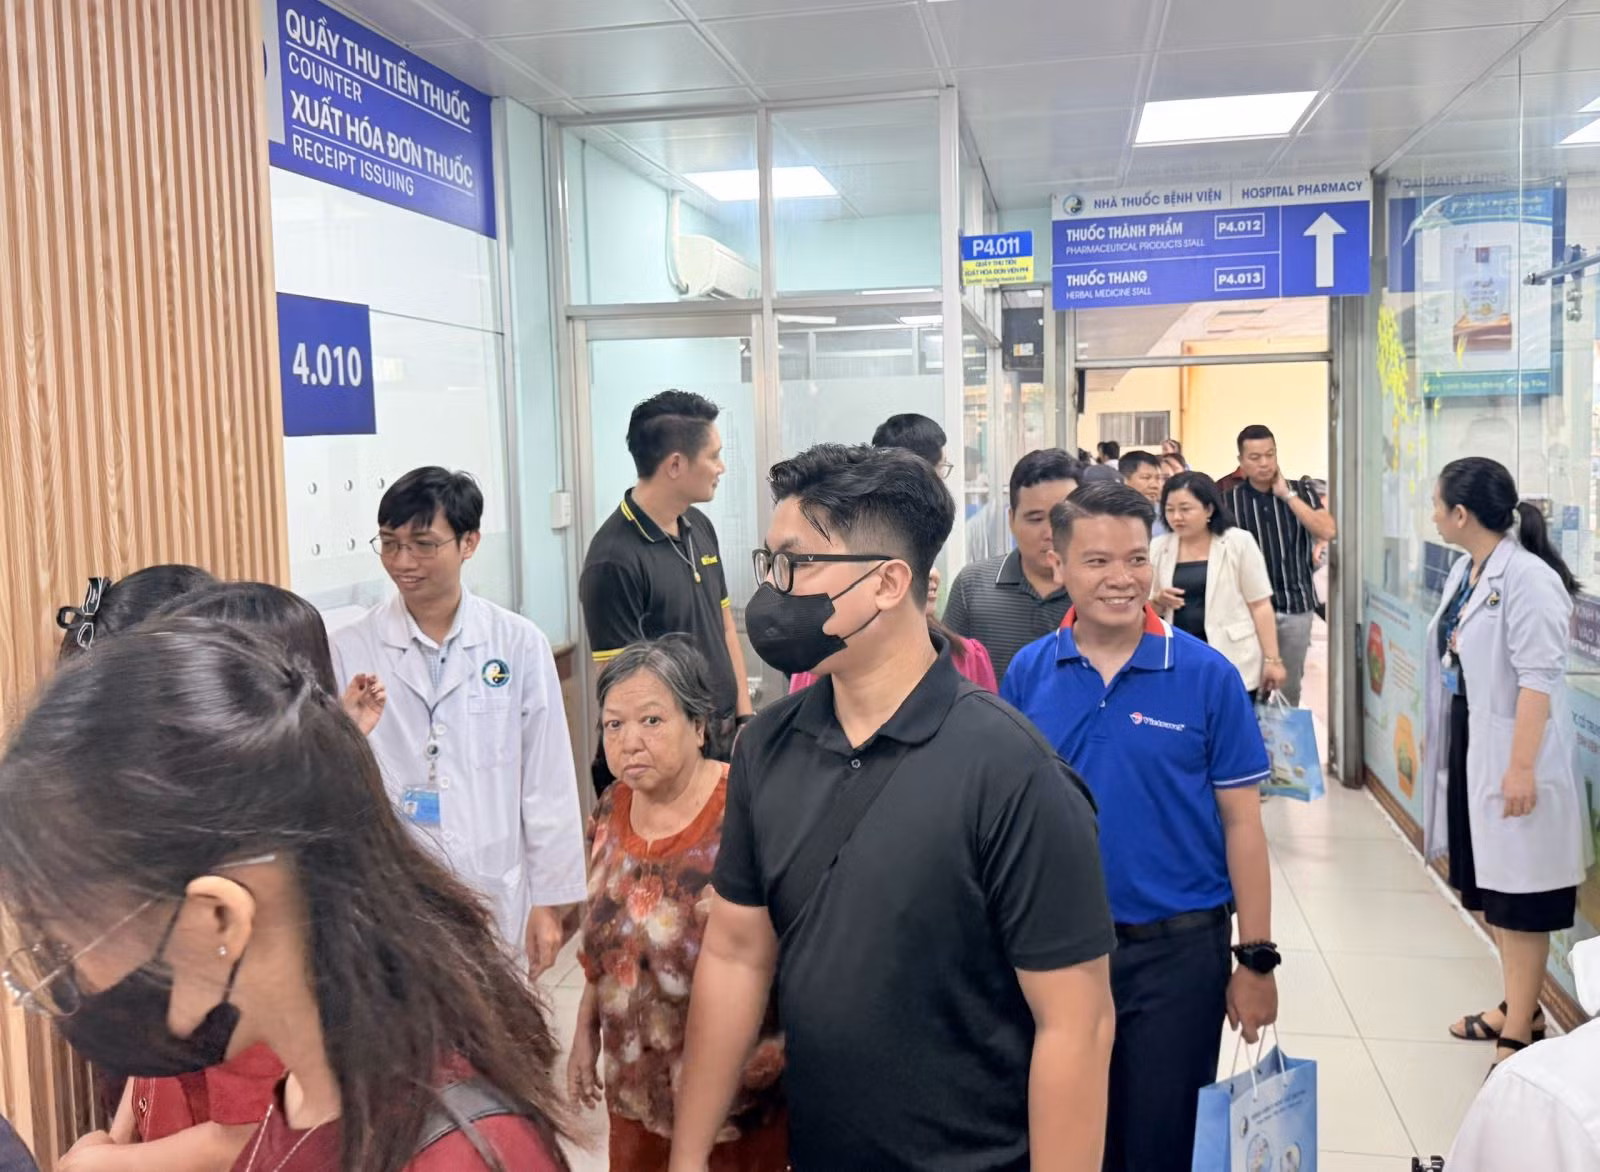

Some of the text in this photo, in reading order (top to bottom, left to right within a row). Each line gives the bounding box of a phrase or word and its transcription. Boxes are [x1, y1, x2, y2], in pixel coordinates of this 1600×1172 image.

[286, 8, 471, 126] QUẦY THU TIỀN THUỐC
[288, 52, 362, 104] COUNTER
[290, 90, 473, 189] XUẤT HÓA ĐƠN THUỐC
[292, 134, 414, 197] RECEIPT ISSUING
[1094, 187, 1222, 209] NHÀ THUỐC BỆNH VIỆN
[1241, 181, 1363, 200] HOSPITAL PHARMACY
[1066, 217, 1183, 242] THUỐC THÀNH PHẨM
[1218, 219, 1262, 234] P4.012
[972, 236, 1020, 257] P4.011
[1065, 238, 1206, 256] PHARMACEUTICAL PRODUCTS STALL
[1066, 268, 1148, 287] THUỐC THANG
[1217, 272, 1262, 286] P4.013
[1066, 286, 1153, 300] HERBAL MEDICINE STALL
[292, 342, 362, 387] 4.010
